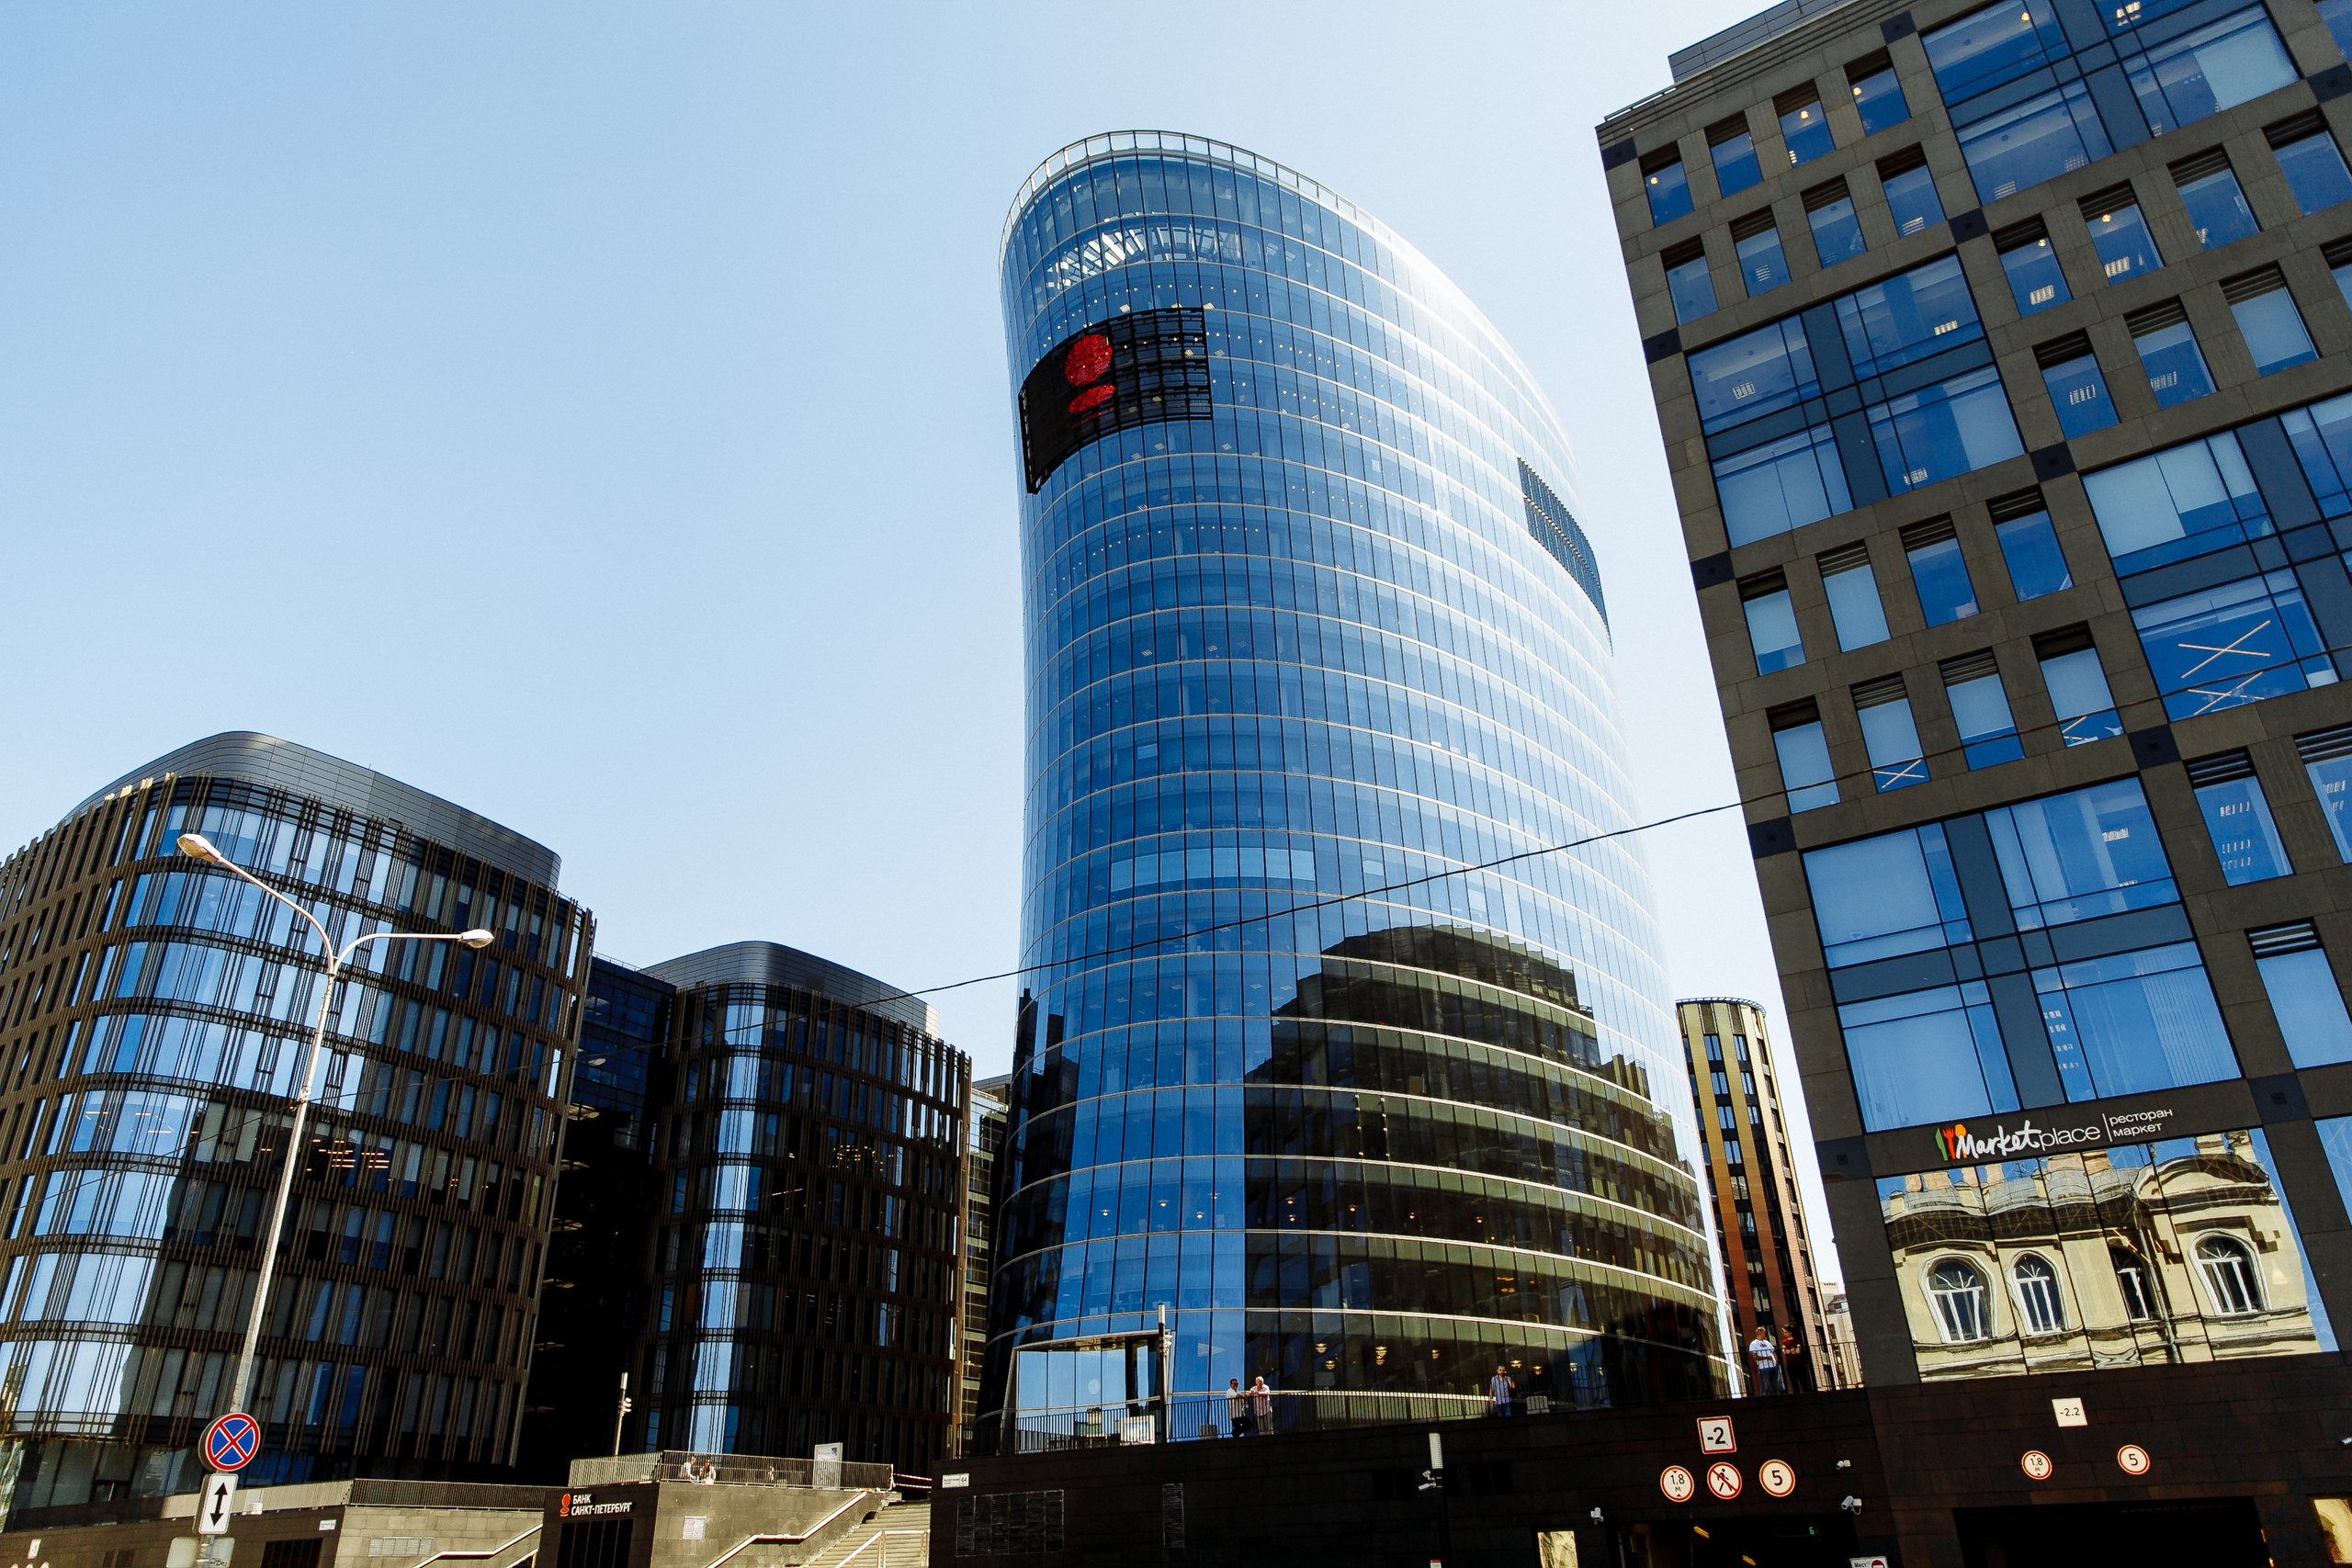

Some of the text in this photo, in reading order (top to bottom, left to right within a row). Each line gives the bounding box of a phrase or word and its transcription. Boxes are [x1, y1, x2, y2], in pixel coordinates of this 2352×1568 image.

[2109, 1108, 2173, 1126] ресторан
[2112, 1122, 2162, 1138] маркет
[2060, 1406, 2080, 1416] -2.2
[1707, 1427, 1726, 1445] -2
[2128, 1454, 2139, 1466] 5
[1670, 1473, 1685, 1485] 1,8
[1771, 1470, 1782, 1486] 5
[572, 1494, 592, 1505] БАНК
[571, 1502, 632, 1516] САНКТ-ПЕТЕРБУРГ
